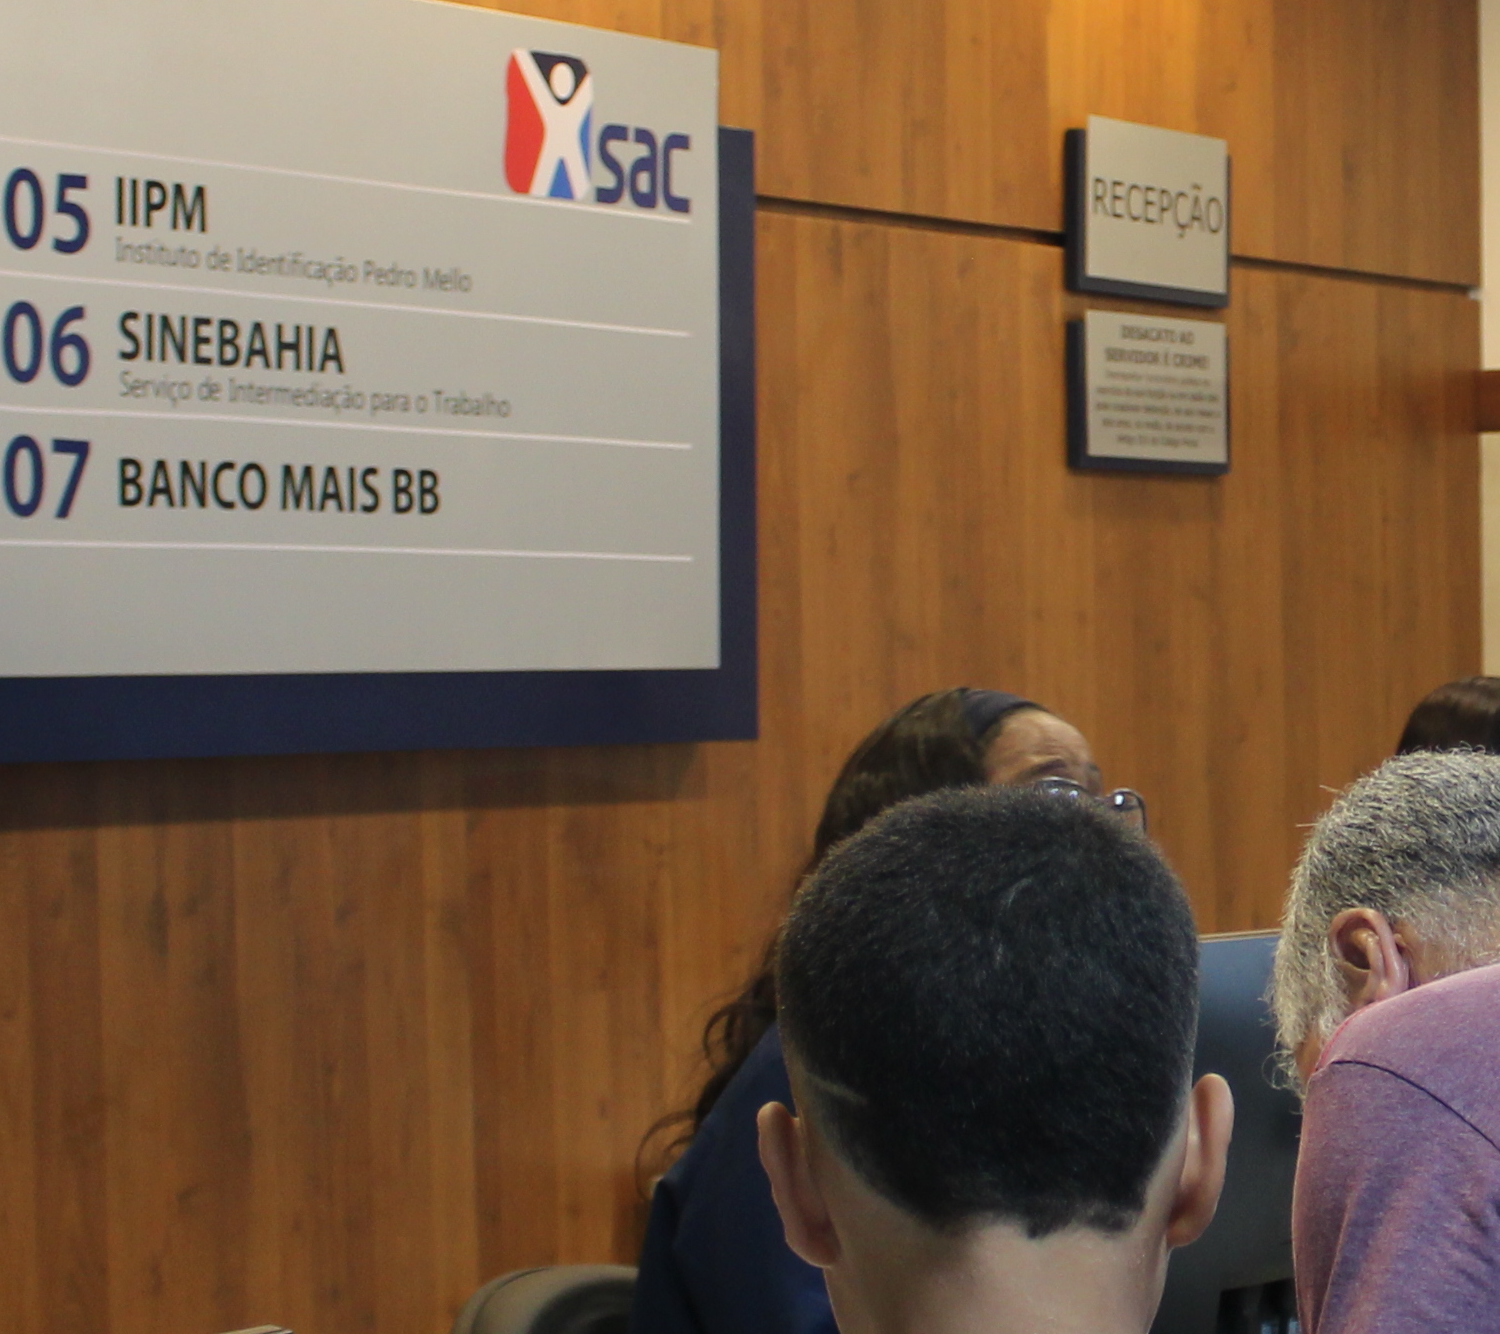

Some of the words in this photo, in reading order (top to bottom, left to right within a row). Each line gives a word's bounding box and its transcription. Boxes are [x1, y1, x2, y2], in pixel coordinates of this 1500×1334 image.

[595, 124, 690, 213] sac
[1, 167, 90, 255] 05
[115, 176, 208, 233] IIPM
[1092, 177, 1224, 239] RECEPÇÃO
[115, 236, 199, 269] Instituto
[206, 245, 231, 273] de
[236, 247, 357, 288] Identificação
[363, 259, 417, 289] Pedro
[1, 300, 90, 387] 06
[118, 311, 345, 374] SINEBAHIA
[119, 371, 193, 407] Serviço
[199, 376, 222, 402] de
[228, 378, 364, 415] Intermediação
[369, 390, 410, 417] para
[415, 394, 428, 413] o
[433, 388, 512, 419] Trabalho
[1, 435, 90, 519] 07
[118, 458, 268, 510] BANCO
[281, 463, 379, 513] MAIS
[392, 468, 440, 515] BB
